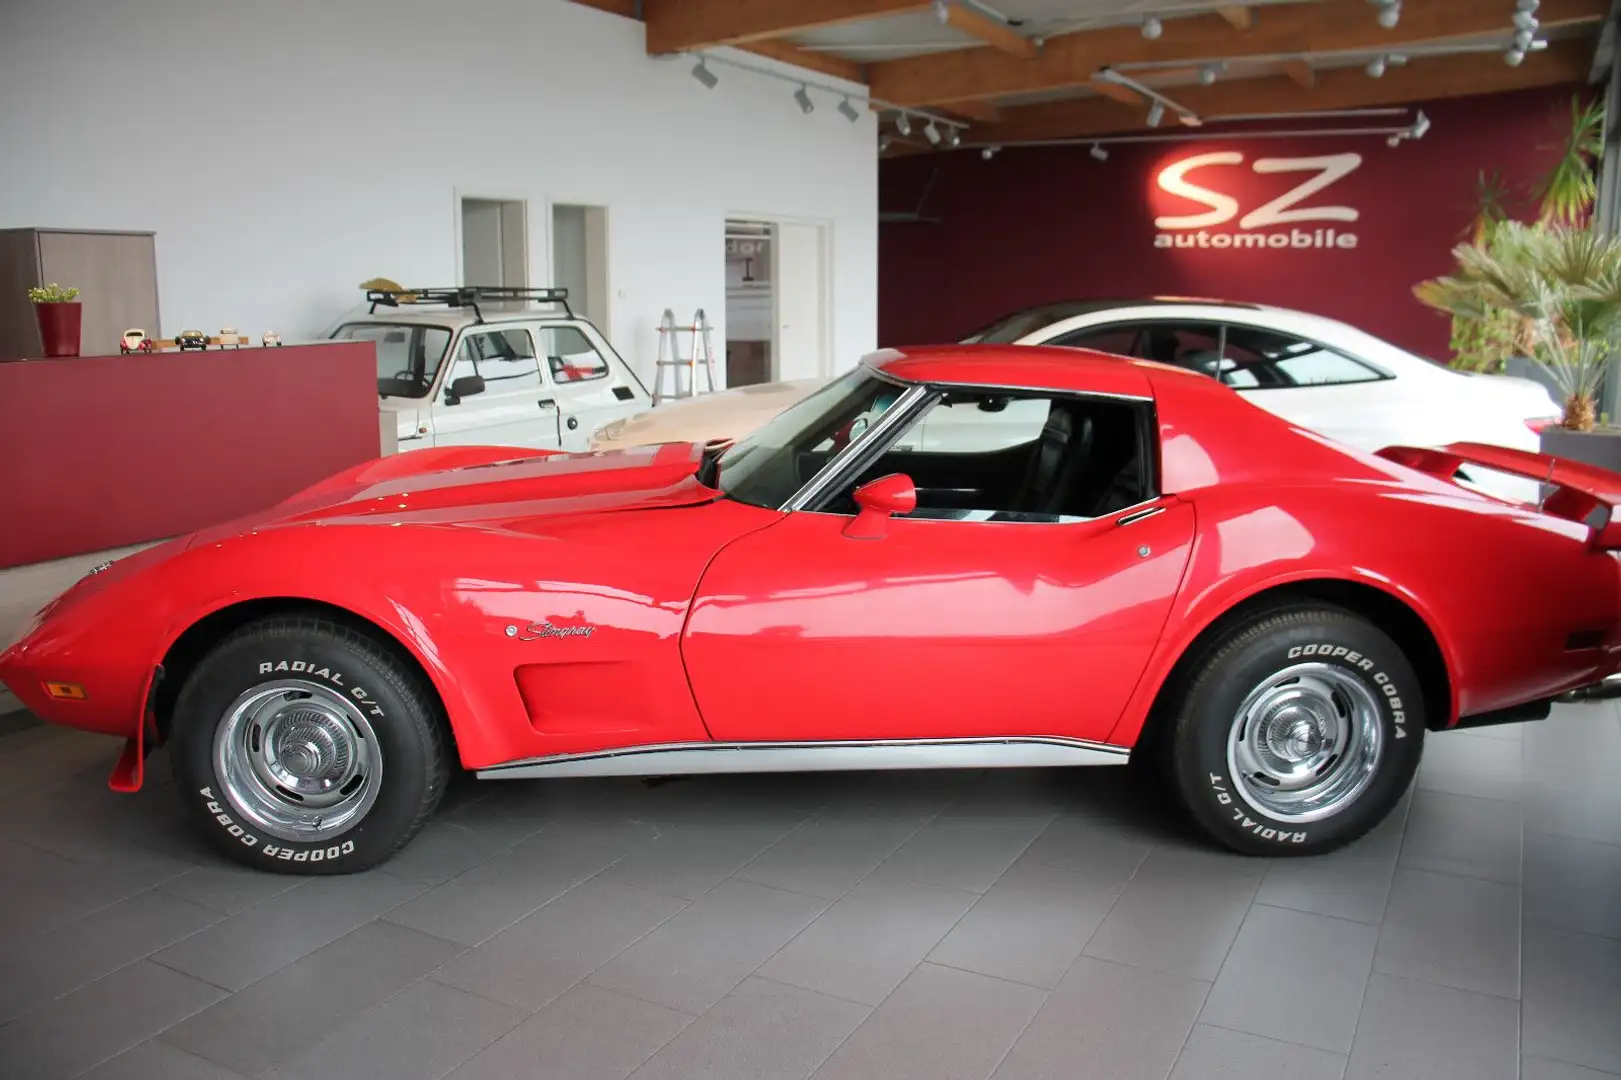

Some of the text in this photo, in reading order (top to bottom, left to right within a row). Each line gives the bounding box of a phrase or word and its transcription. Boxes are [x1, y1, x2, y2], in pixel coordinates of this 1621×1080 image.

[1154, 151, 1362, 230] SZ
[1154, 229, 1358, 249] automobile
[519, 622, 597, 641] Stingray
[258, 660, 385, 718] RADIAL G/T
[1287, 644, 1407, 739] COOPER COBRA
[199, 786, 356, 862] COOPER COBRA
[1209, 772, 1308, 844] RADIAL G/T
